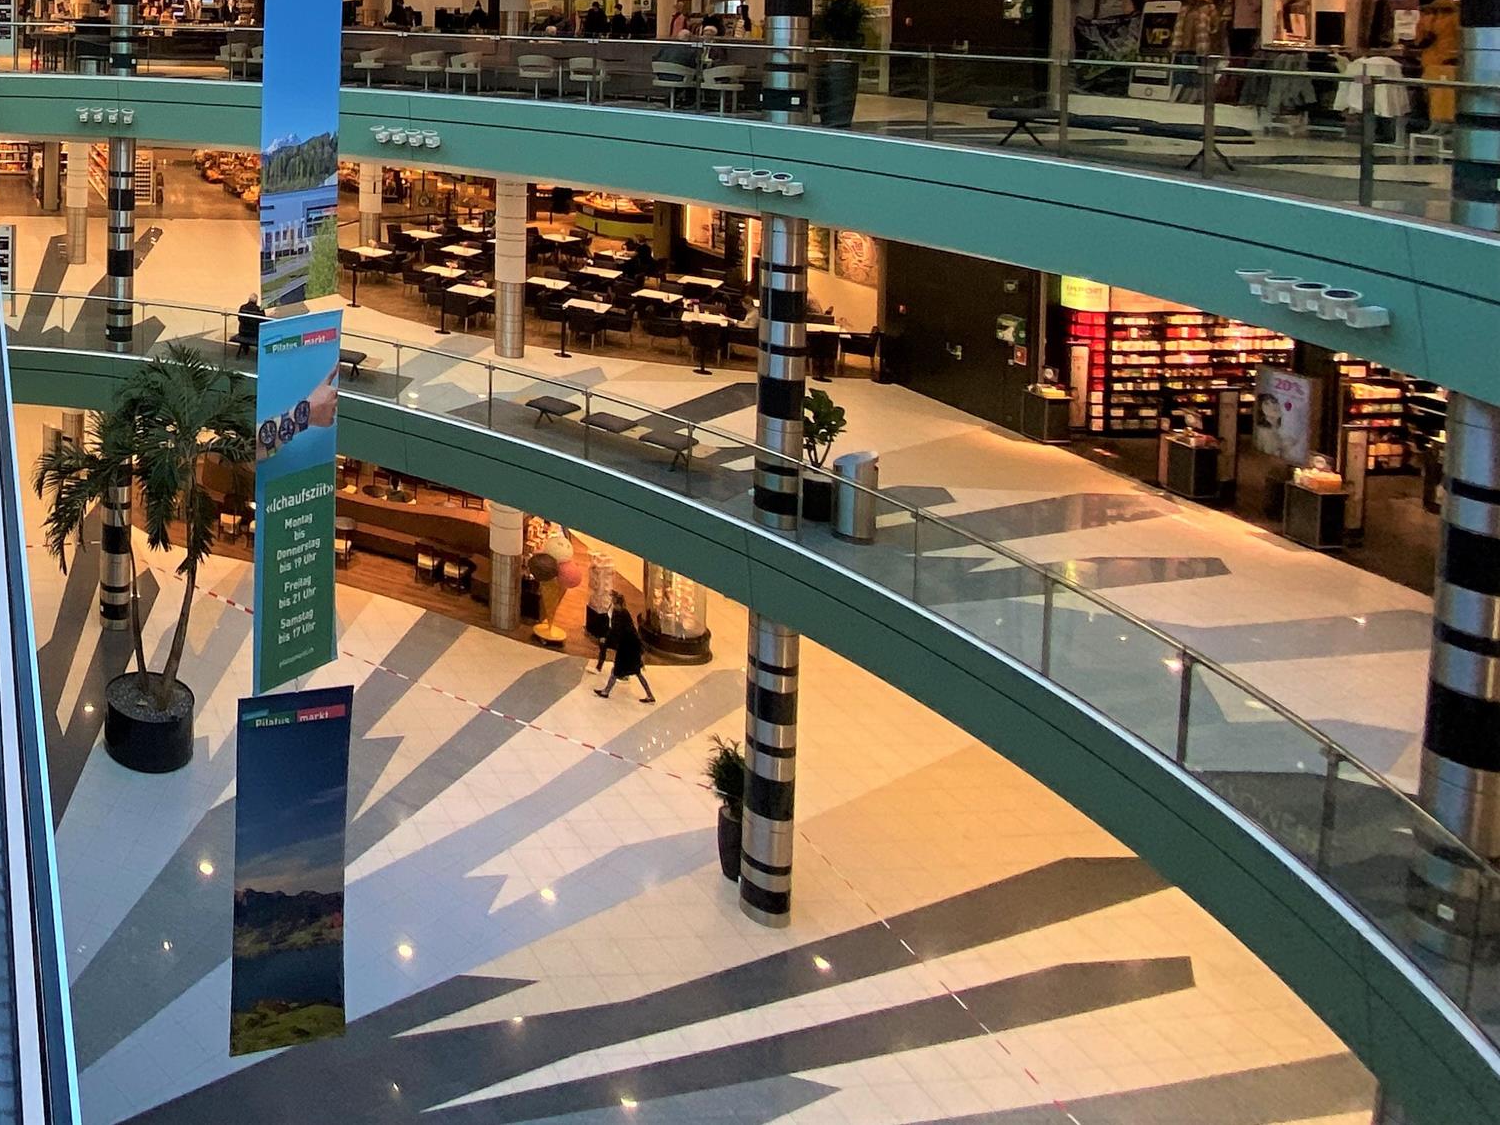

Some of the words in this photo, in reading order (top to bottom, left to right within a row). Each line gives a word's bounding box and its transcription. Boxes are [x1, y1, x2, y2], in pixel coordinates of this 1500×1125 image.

[271, 341, 299, 354] Pilatus
[303, 334, 327, 347] markt
[284, 512, 313, 529] Montag
[294, 529, 305, 541] bis
[276, 537, 321, 561] Donnerstag
[279, 560, 291, 573] bis
[294, 556, 302, 569] 19
[303, 552, 317, 565] Uhr
[284, 575, 312, 593] Freitag
[278, 597, 291, 609] bis
[292, 591, 301, 604] 21
[303, 586, 317, 599] Uhr
[280, 608, 314, 630] Samstag
[278, 631, 290, 644] bis
[292, 626, 301, 638] 17
[302, 621, 316, 634] Uhr
[255, 716, 291, 729] Pilatus
[299, 711, 329, 723] markt
